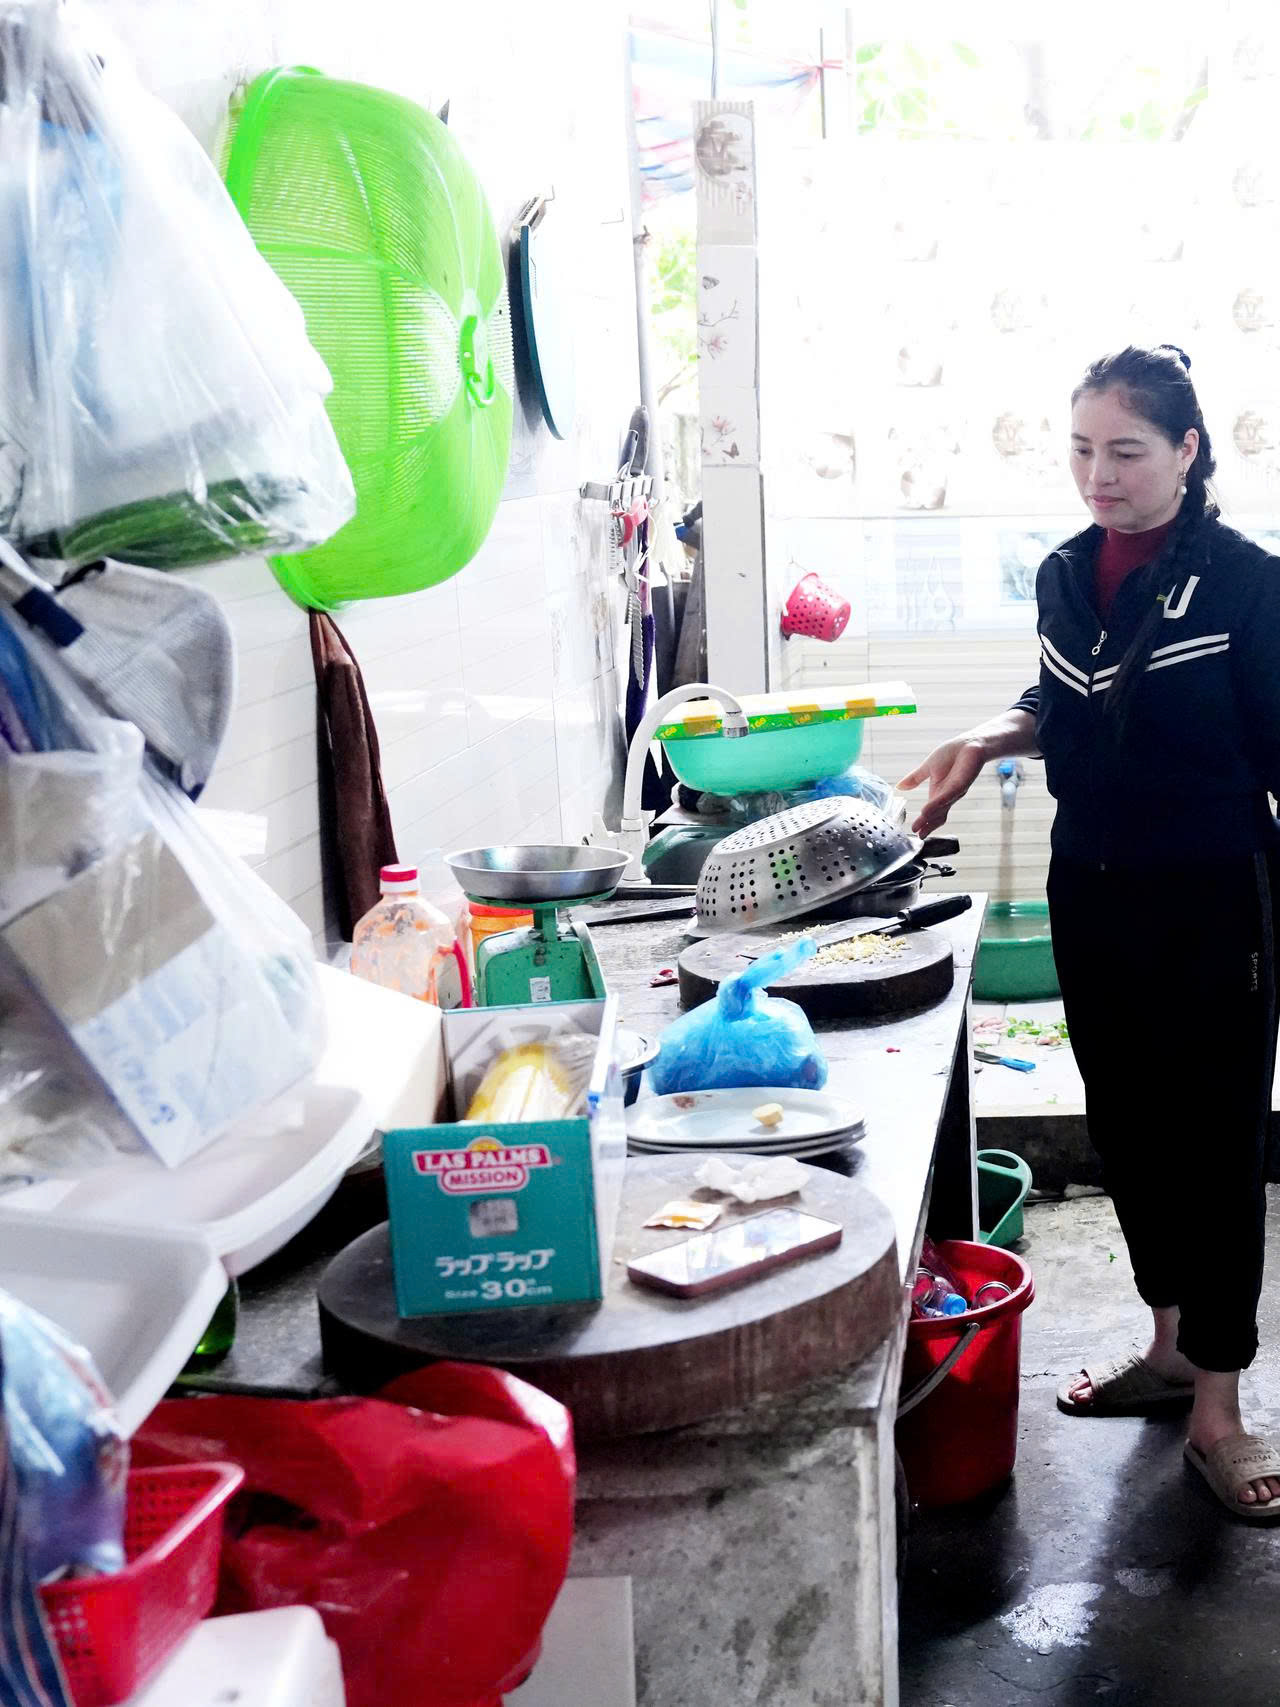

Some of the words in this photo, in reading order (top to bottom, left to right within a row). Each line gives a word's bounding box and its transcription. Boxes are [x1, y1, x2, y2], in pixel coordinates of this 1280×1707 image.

[1250, 951, 1259, 991] SPORTS
[425, 1153, 466, 1169] LAS
[471, 1148, 541, 1167] PALMS
[450, 1171, 518, 1185] MISSION
